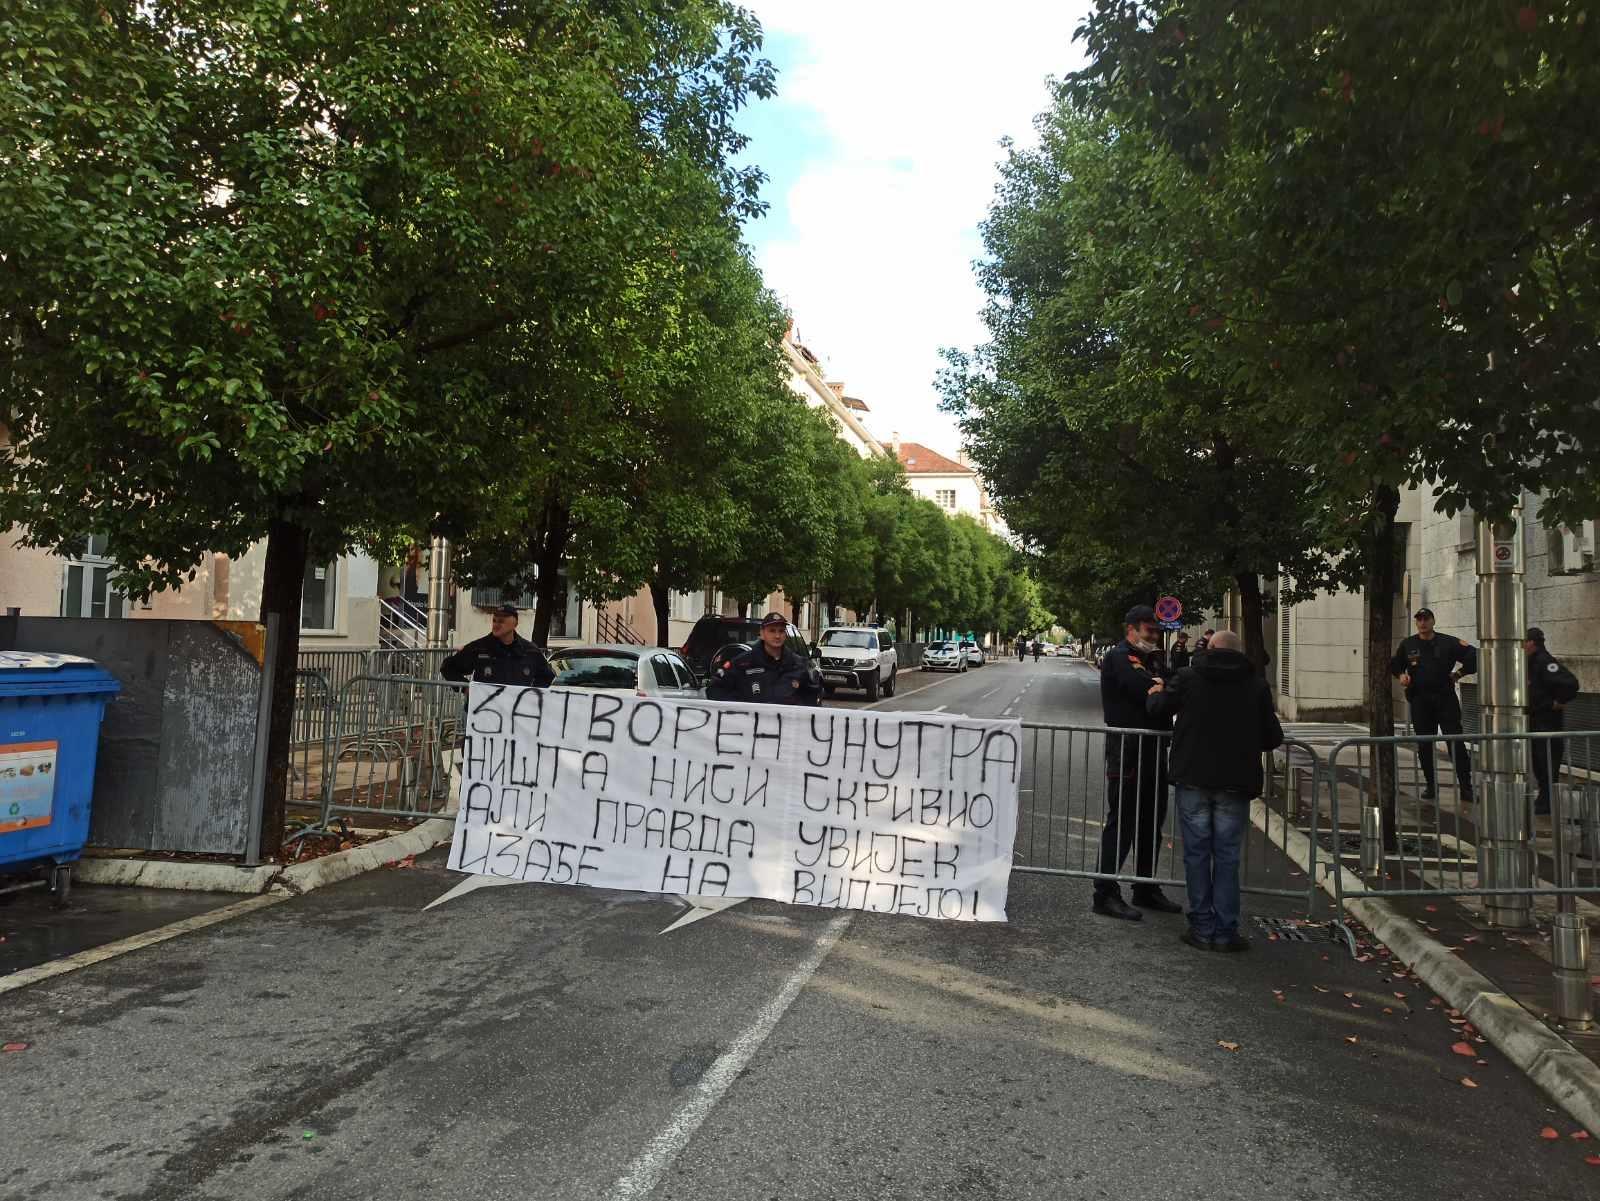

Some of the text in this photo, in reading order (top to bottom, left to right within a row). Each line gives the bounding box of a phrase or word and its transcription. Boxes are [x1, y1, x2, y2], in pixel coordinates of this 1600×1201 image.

[471, 684, 1018, 783] ЗАТВОРЕН УНУТРА
[465, 736, 994, 828] НИШТА НИСИ СКРИВИО
[465, 782, 960, 880] АЛИ ПРАВДА УВИЈЕК
[661, 854, 730, 896] НА
